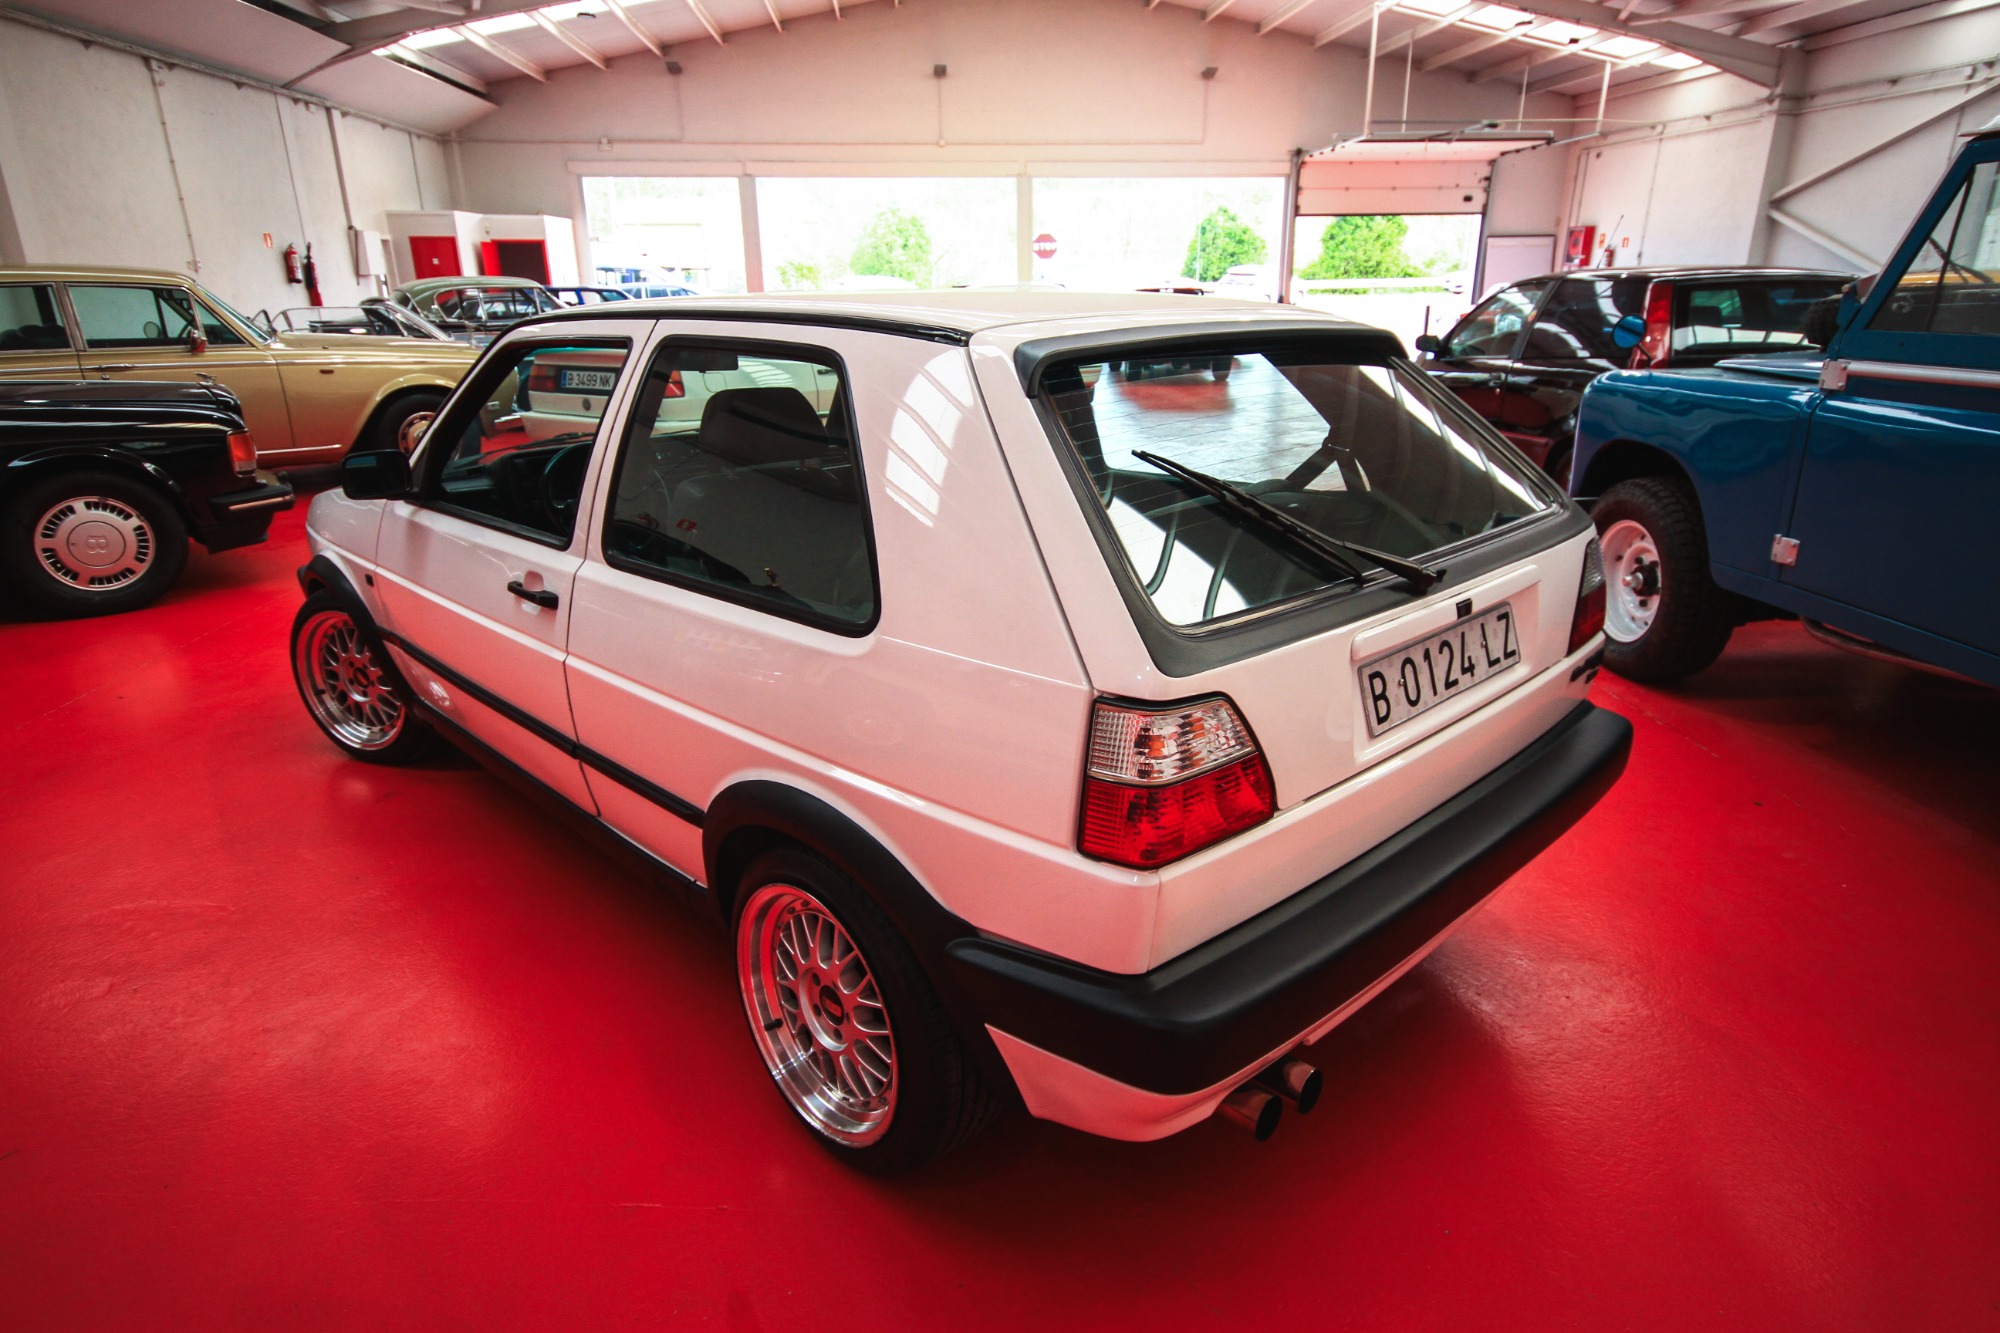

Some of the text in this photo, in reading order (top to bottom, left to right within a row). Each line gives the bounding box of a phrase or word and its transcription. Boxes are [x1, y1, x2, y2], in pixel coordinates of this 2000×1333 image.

[1032, 242, 1057, 251] STOP
[575, 373, 597, 387] 3499
[600, 374, 612, 388] NK
[1368, 611, 1516, 725] B 0124 LZ
